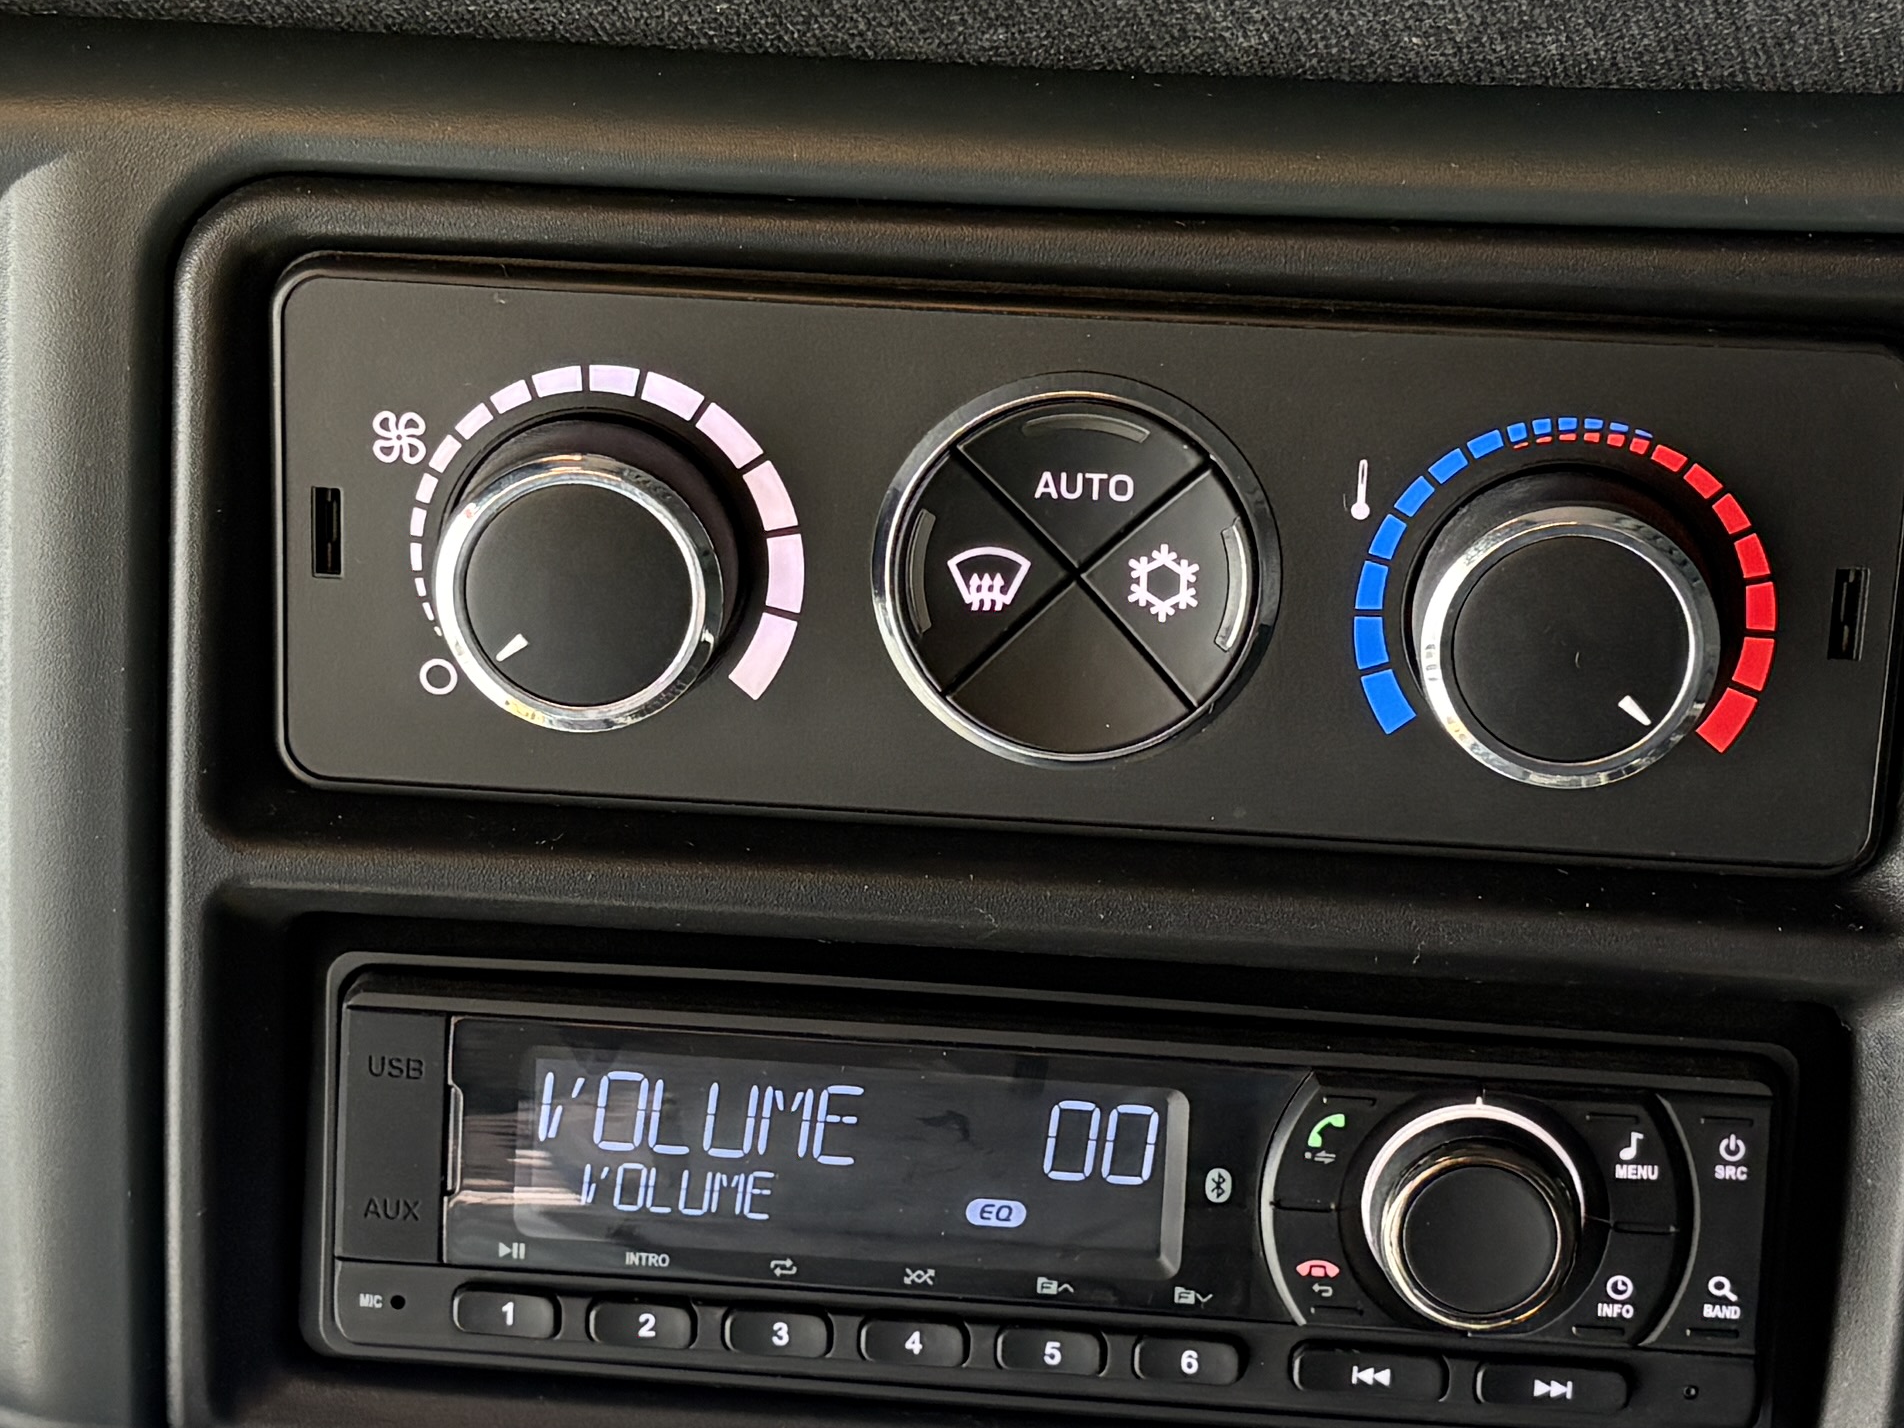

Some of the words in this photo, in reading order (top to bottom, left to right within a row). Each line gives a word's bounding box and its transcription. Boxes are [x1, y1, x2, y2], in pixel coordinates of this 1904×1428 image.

[1034, 471, 1134, 502] AUTO
[368, 1055, 424, 1080] USB
[538, 1071, 865, 1165] VOLUME
[1042, 1100, 1159, 1186] 00
[1615, 1163, 1659, 1181] MENU
[1714, 1164, 1748, 1181] SRC
[580, 1163, 775, 1220] VOLUME
[364, 1197, 420, 1222] AUX
[979, 1203, 1014, 1222] EQ
[625, 1251, 670, 1268] INTRO
[359, 1293, 383, 1309] MIC
[1597, 1302, 1634, 1319] INFO
[1702, 1303, 1741, 1320] BAND
[501, 1301, 515, 1327] 1
[637, 1313, 656, 1338] 2
[771, 1321, 790, 1347] 3
[904, 1330, 923, 1355] 4
[1043, 1341, 1062, 1366] 5
[1180, 1349, 1199, 1375] 6
